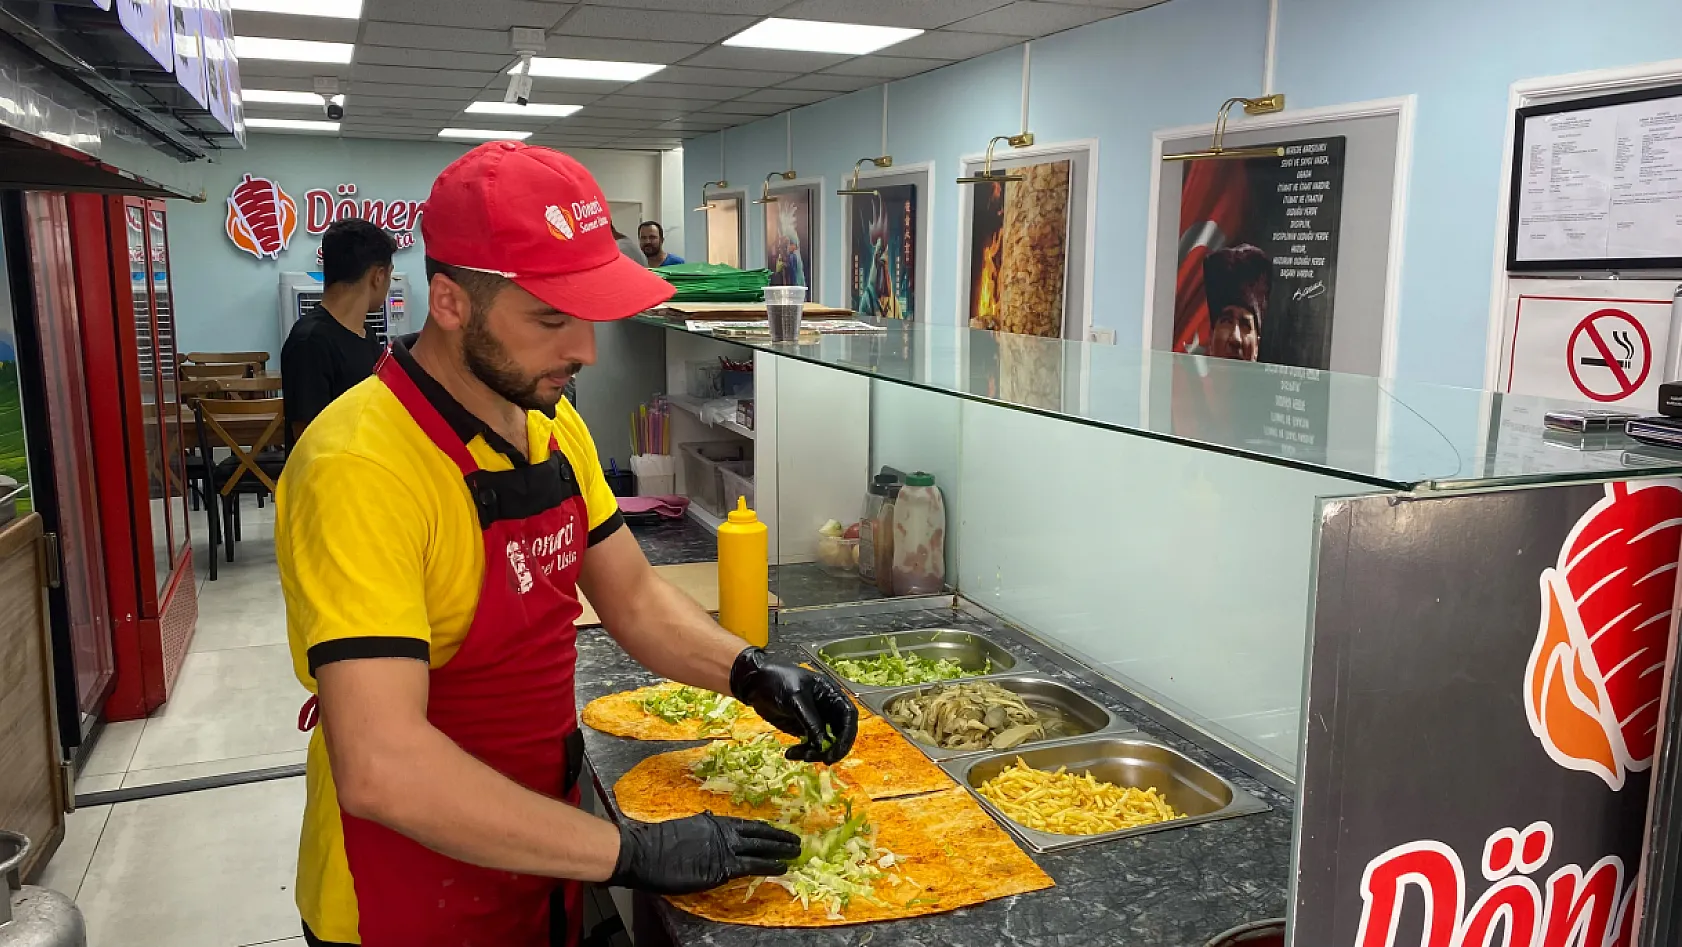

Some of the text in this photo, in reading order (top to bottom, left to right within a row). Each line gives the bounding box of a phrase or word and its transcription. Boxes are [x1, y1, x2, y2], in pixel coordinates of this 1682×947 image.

[1293, 158, 1300, 167] VE
[1292, 183, 1299, 192] VE
[1298, 195, 1305, 204] VE
[303, 183, 427, 234] Döner
[394, 231, 417, 249] ta
[1354, 821, 1641, 947] Dön
